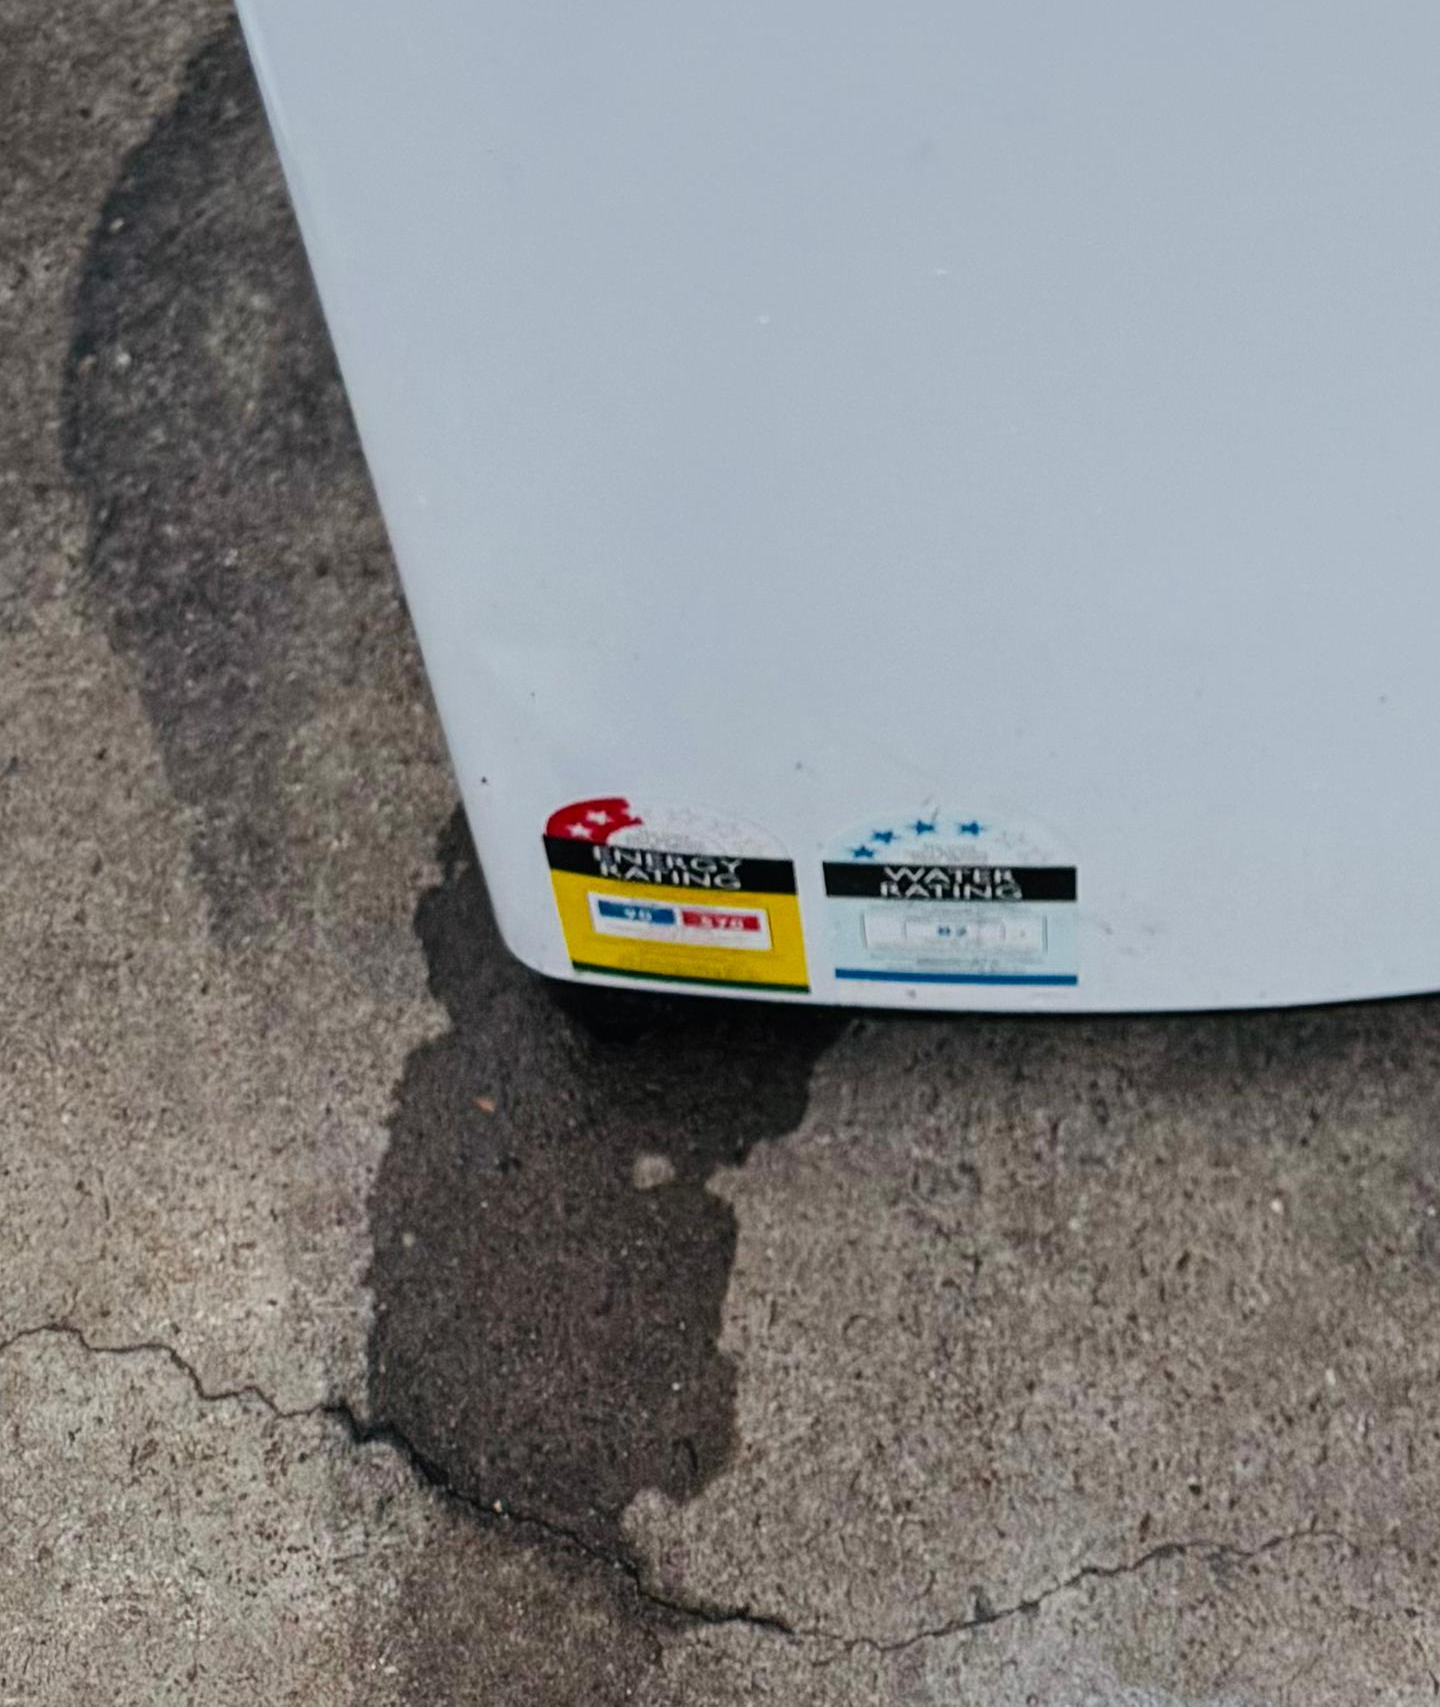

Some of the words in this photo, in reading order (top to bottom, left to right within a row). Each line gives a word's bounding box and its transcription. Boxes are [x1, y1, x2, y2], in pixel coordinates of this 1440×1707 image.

[592, 844, 742, 874] ENERGY
[600, 860, 742, 891] RATING
[884, 866, 1016, 885] WATER
[880, 881, 1023, 900] RATING
